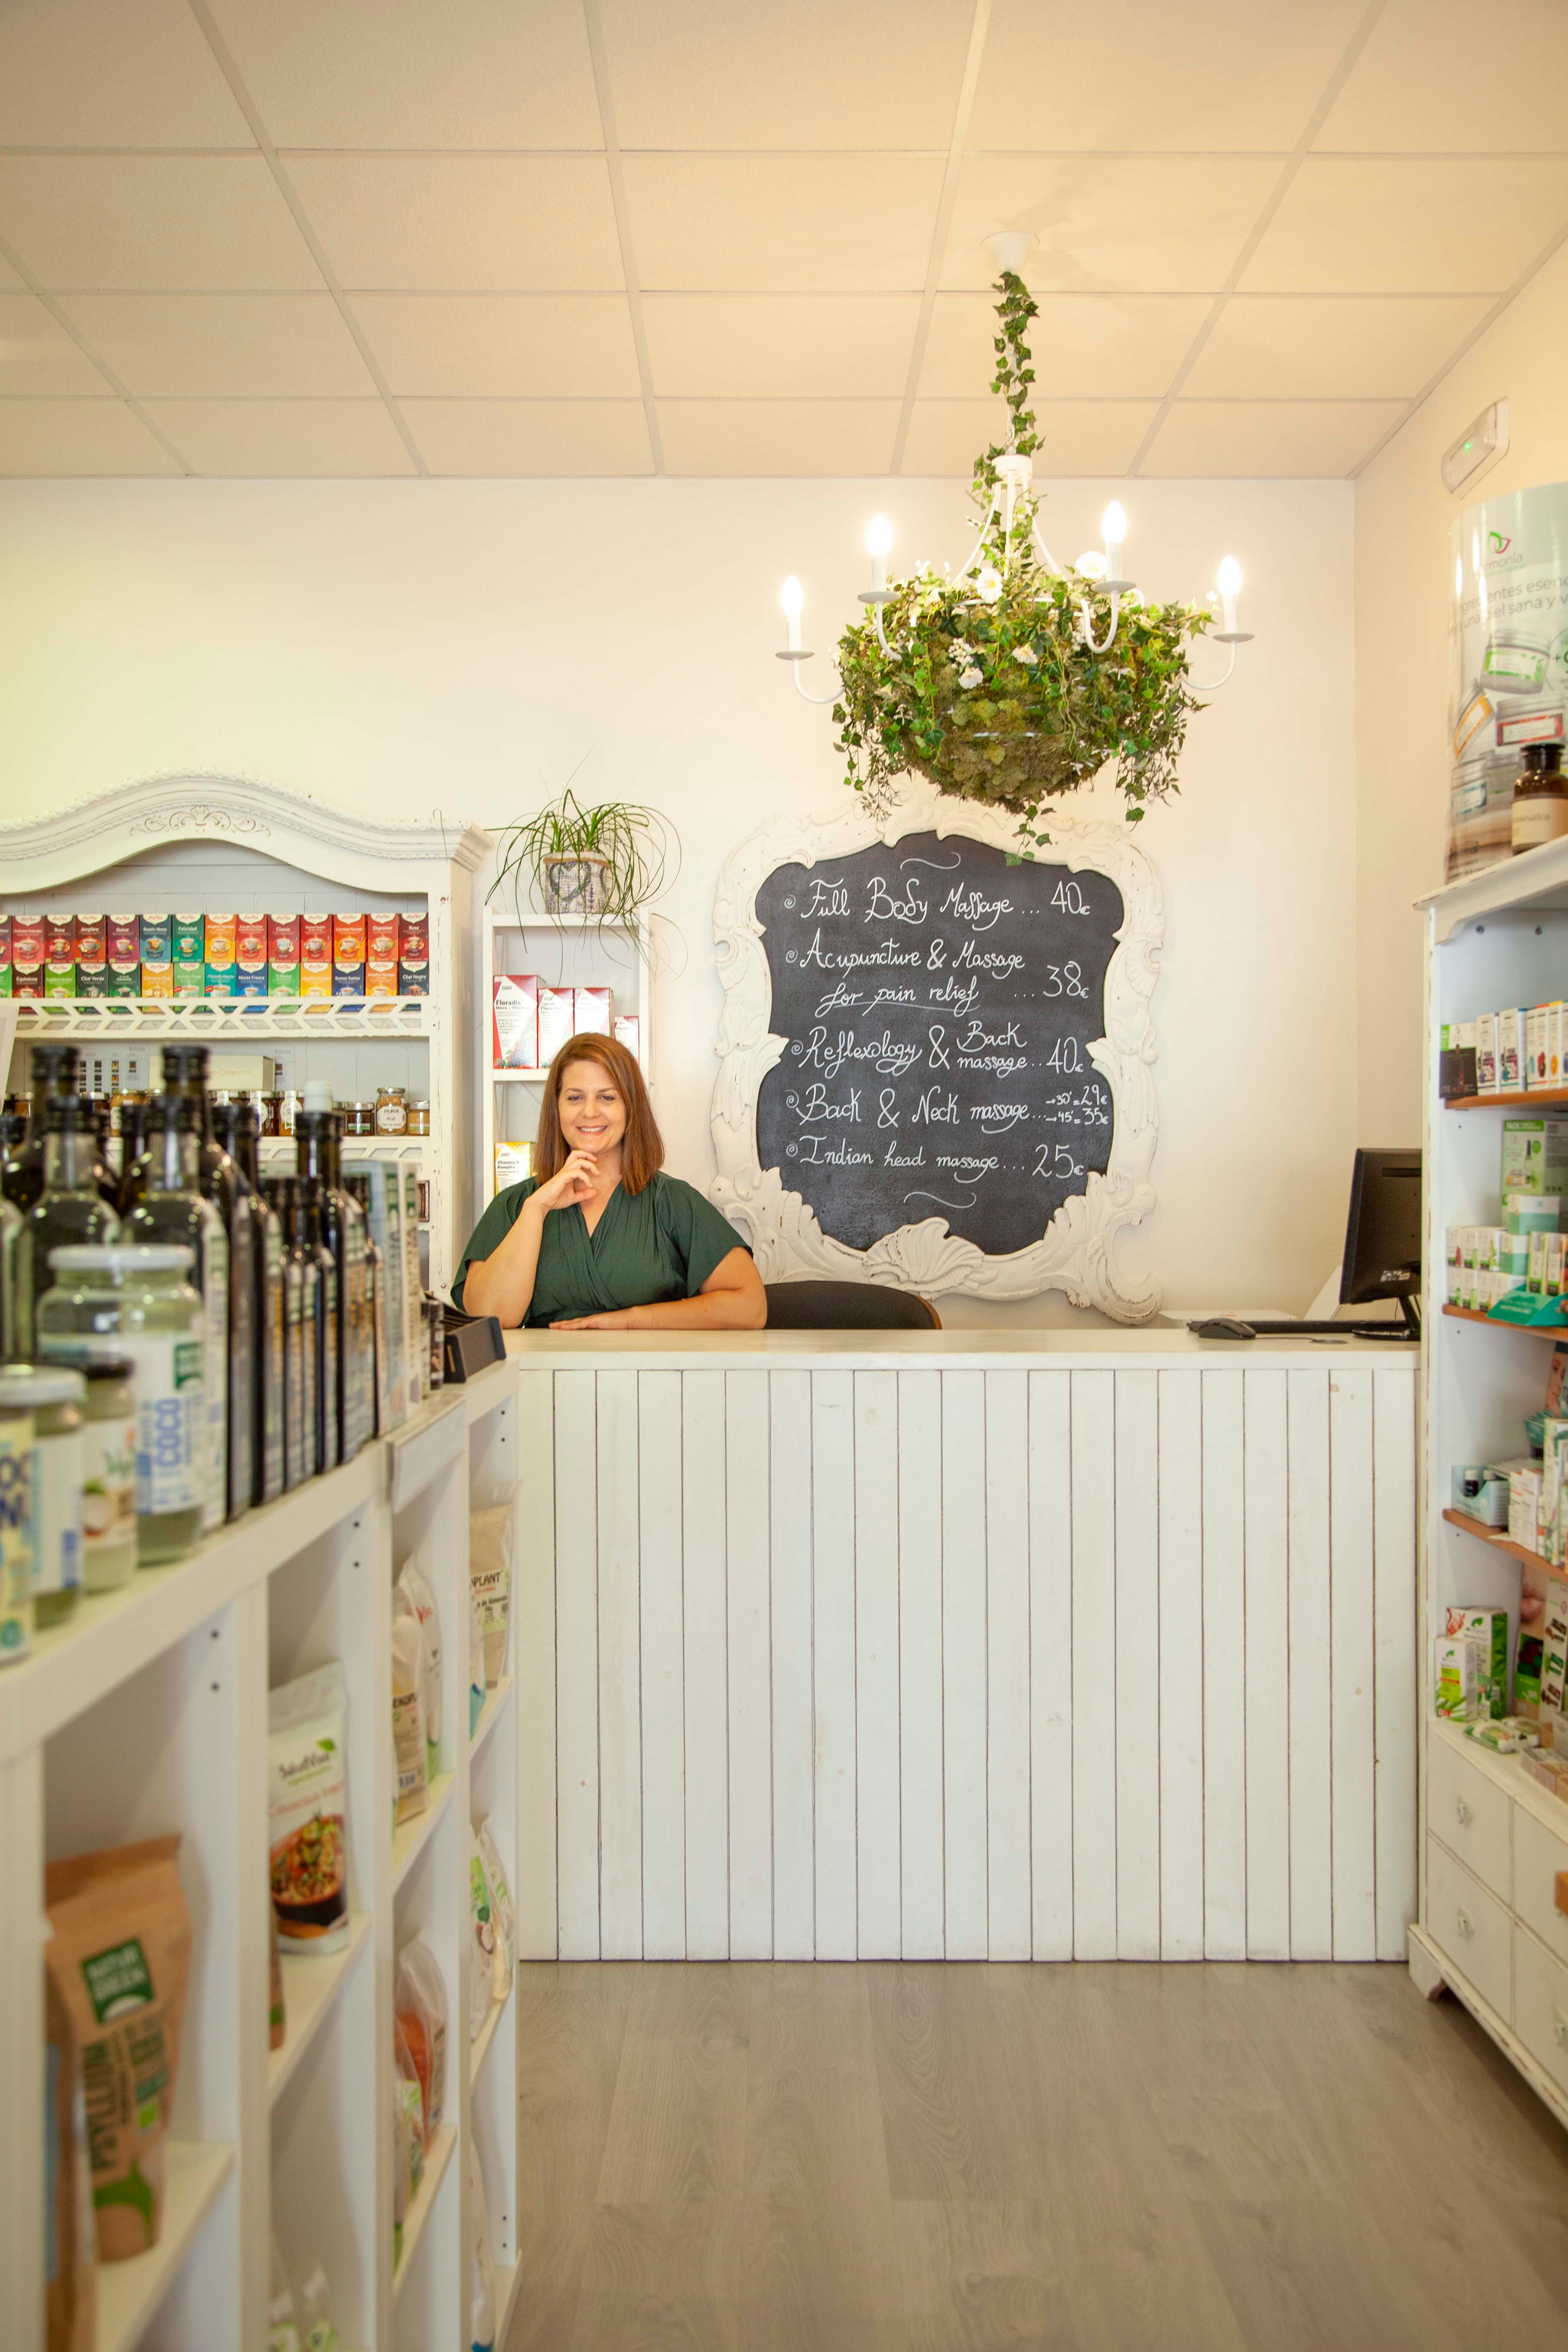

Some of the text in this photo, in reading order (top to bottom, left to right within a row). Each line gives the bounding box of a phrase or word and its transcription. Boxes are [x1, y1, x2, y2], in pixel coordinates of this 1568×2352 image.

[1509, 598, 1542, 614] sana
[801, 879, 850, 917] Full
[864, 877, 928, 924] Body
[800, 928, 1025, 979] Acupuncture & Massage
[815, 983, 862, 1017] for
[862, 989, 916, 1016] pain
[929, 976, 979, 1017] relief
[799, 1020, 1027, 1079] Reflexology & Back
[957, 1057, 1027, 1077] massage
[796, 1083, 861, 1125] Back
[877, 1088, 900, 1128] &
[912, 1085, 960, 1125] Neck
[970, 1104, 1030, 1133] massage
[799, 1135, 873, 1164] Indian
[884, 1140, 925, 1167] head
[937, 1156, 999, 1183] massage
